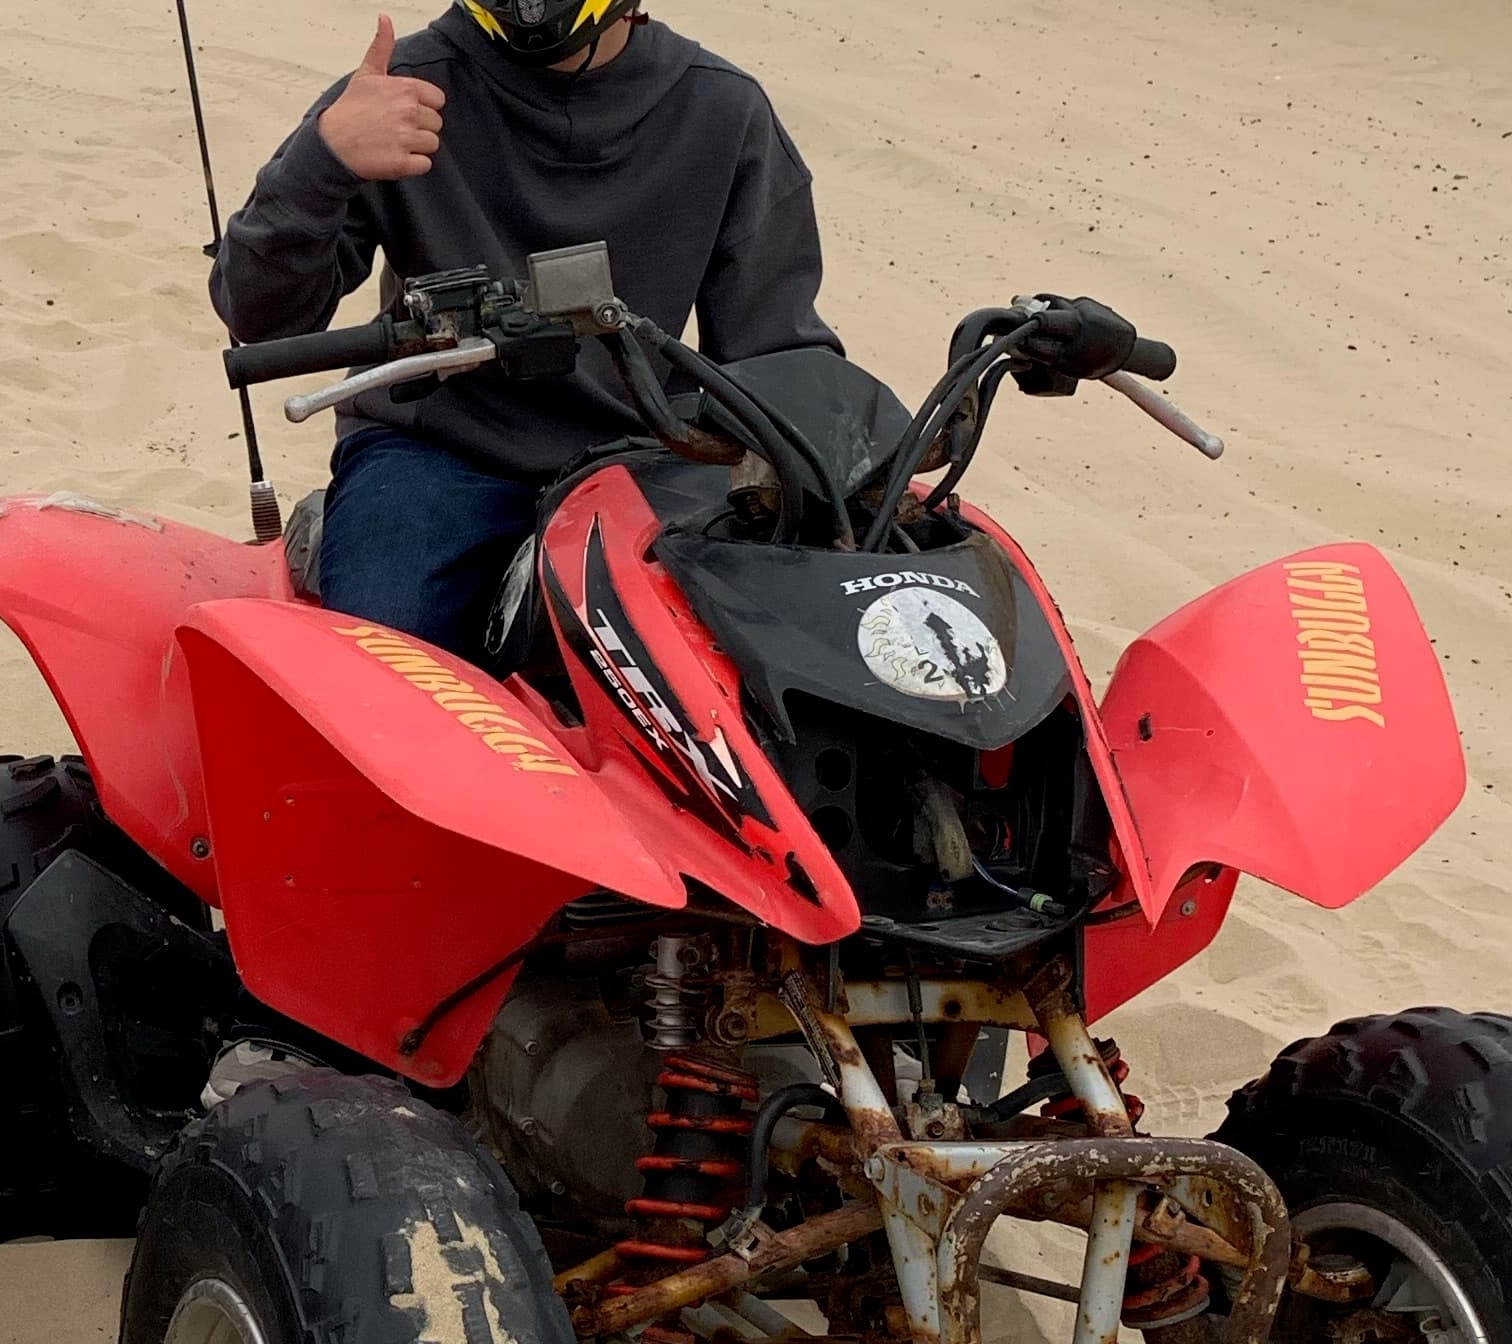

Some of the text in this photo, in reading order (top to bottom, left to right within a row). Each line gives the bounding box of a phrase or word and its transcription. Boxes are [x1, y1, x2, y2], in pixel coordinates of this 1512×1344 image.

[840, 571, 981, 599] HONDA
[1283, 560, 1386, 728] SUNBUGGY
[333, 625, 580, 778] SUNBUGGY
[589, 648, 669, 752] 250EX
[595, 608, 744, 802] TRX
